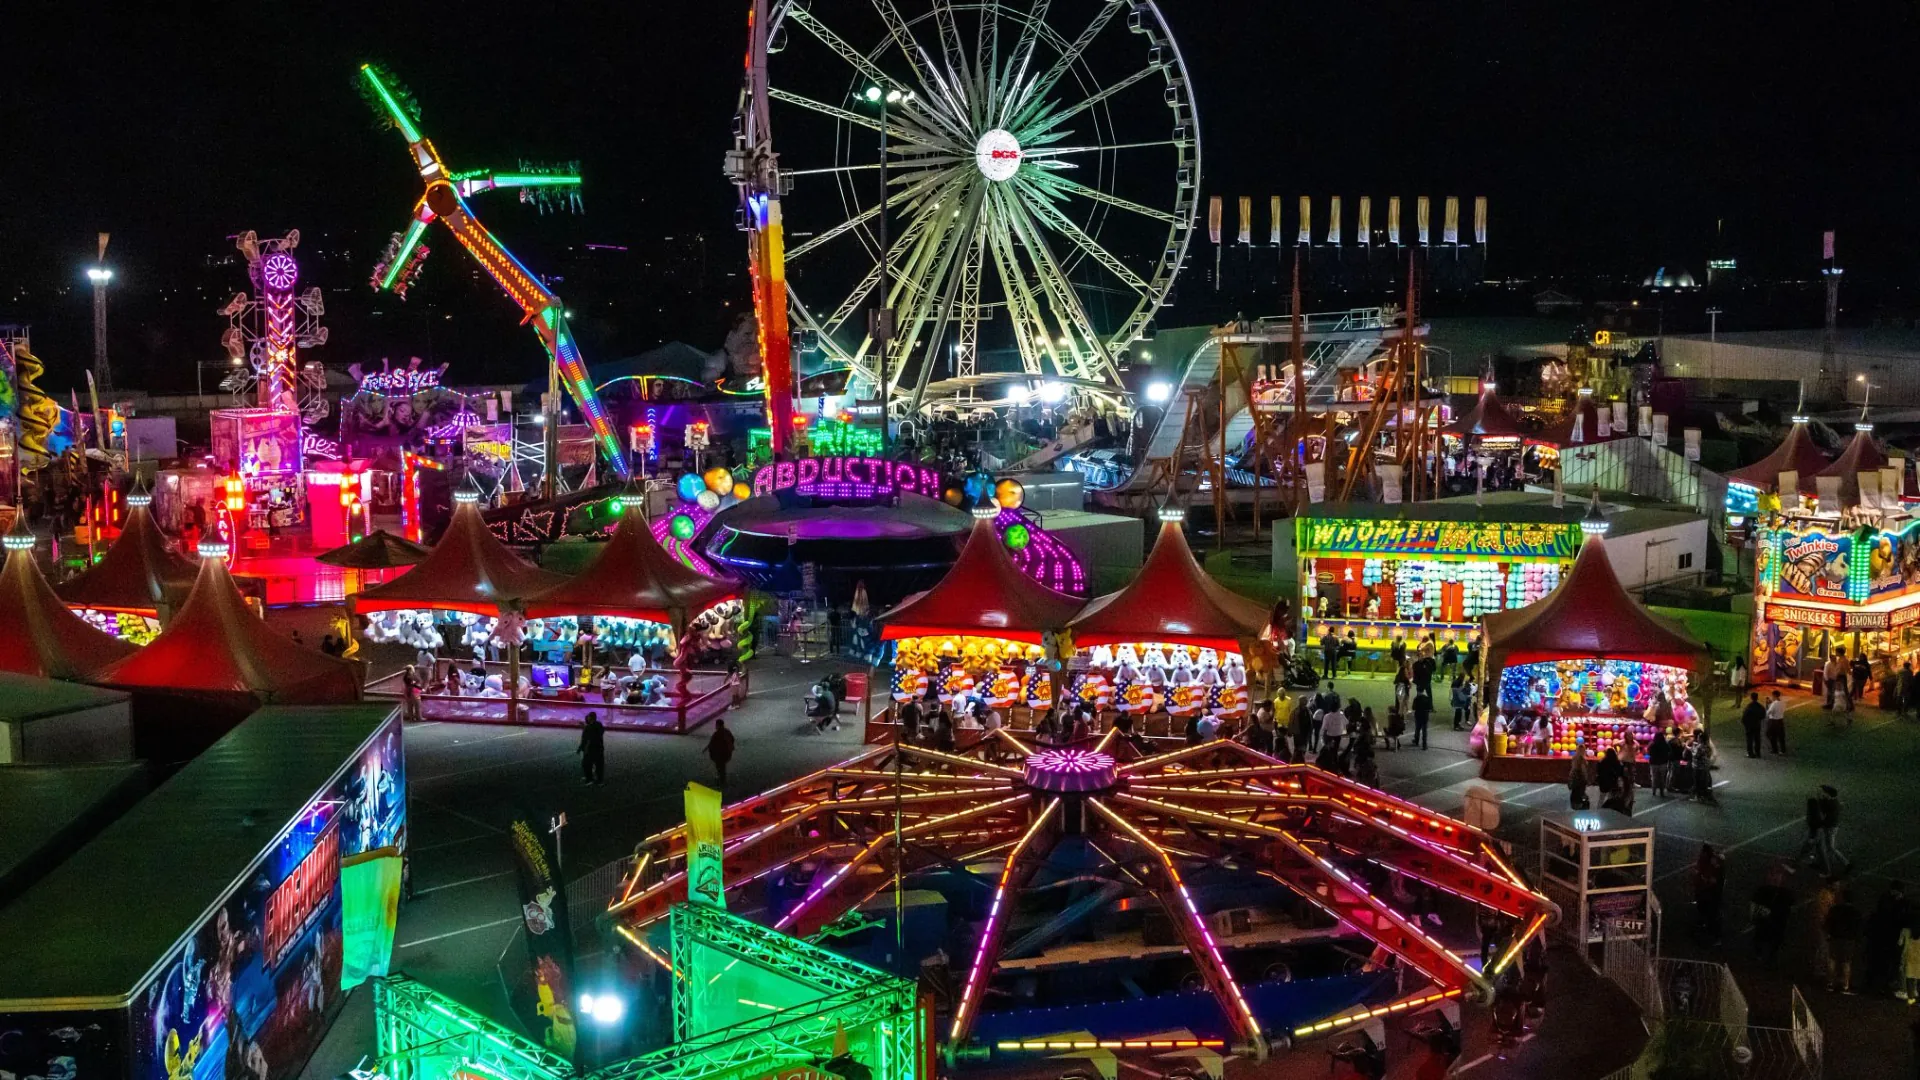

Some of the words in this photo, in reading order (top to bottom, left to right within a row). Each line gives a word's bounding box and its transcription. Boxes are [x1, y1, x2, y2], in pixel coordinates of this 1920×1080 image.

[754, 457, 940, 499] ABDUCTION
[1313, 519, 1439, 545] WHOPPER
[1784, 541, 1839, 562] Twinkies
[1816, 587, 1846, 598] Cream
[1827, 580, 1842, 590] Ice
[1783, 608, 1836, 626] SNICKERS
[1616, 920, 1644, 930] EXIT
